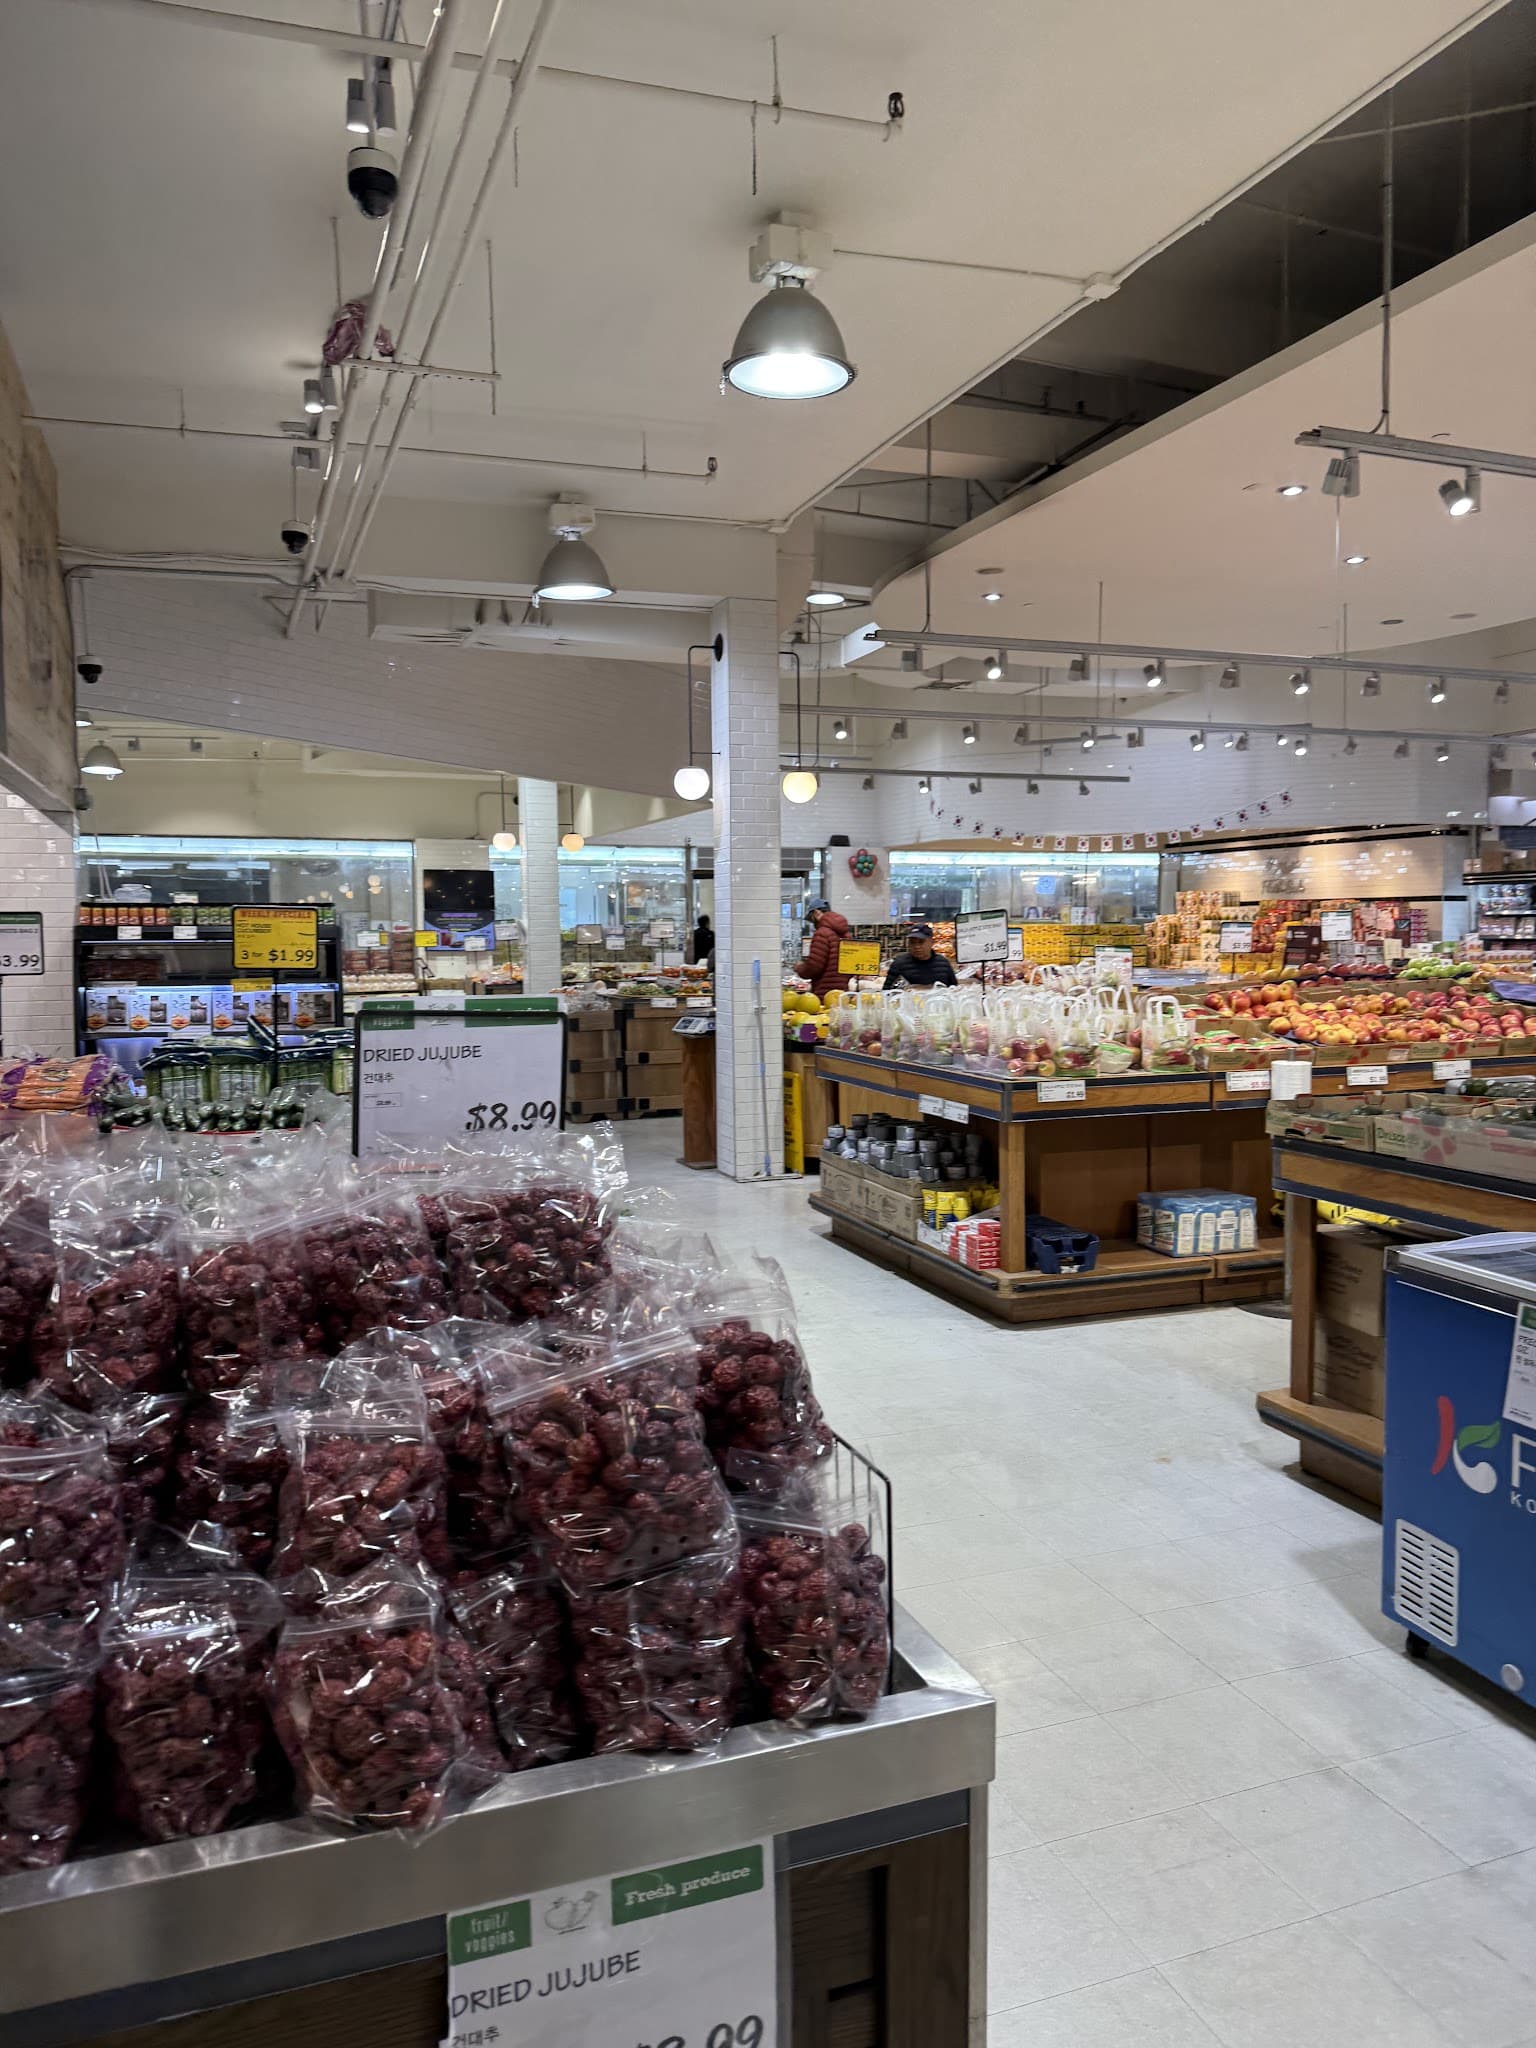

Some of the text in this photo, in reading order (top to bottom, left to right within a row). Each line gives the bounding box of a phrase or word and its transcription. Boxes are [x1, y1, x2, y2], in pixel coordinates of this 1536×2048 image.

[0, 954, 40, 968] 3.99
[241, 949, 249, 960] 3
[268, 949, 314, 963] $1.99
[363, 1044, 482, 1063] DRIED JUJUBE
[363, 1073, 395, 1084] 건대추
[465, 1100, 557, 1132] $8.99
[624, 1864, 752, 1907] Fresh produce
[465, 1929, 516, 1955] veggies
[451, 1949, 642, 2019] DRIED JUJUBE
